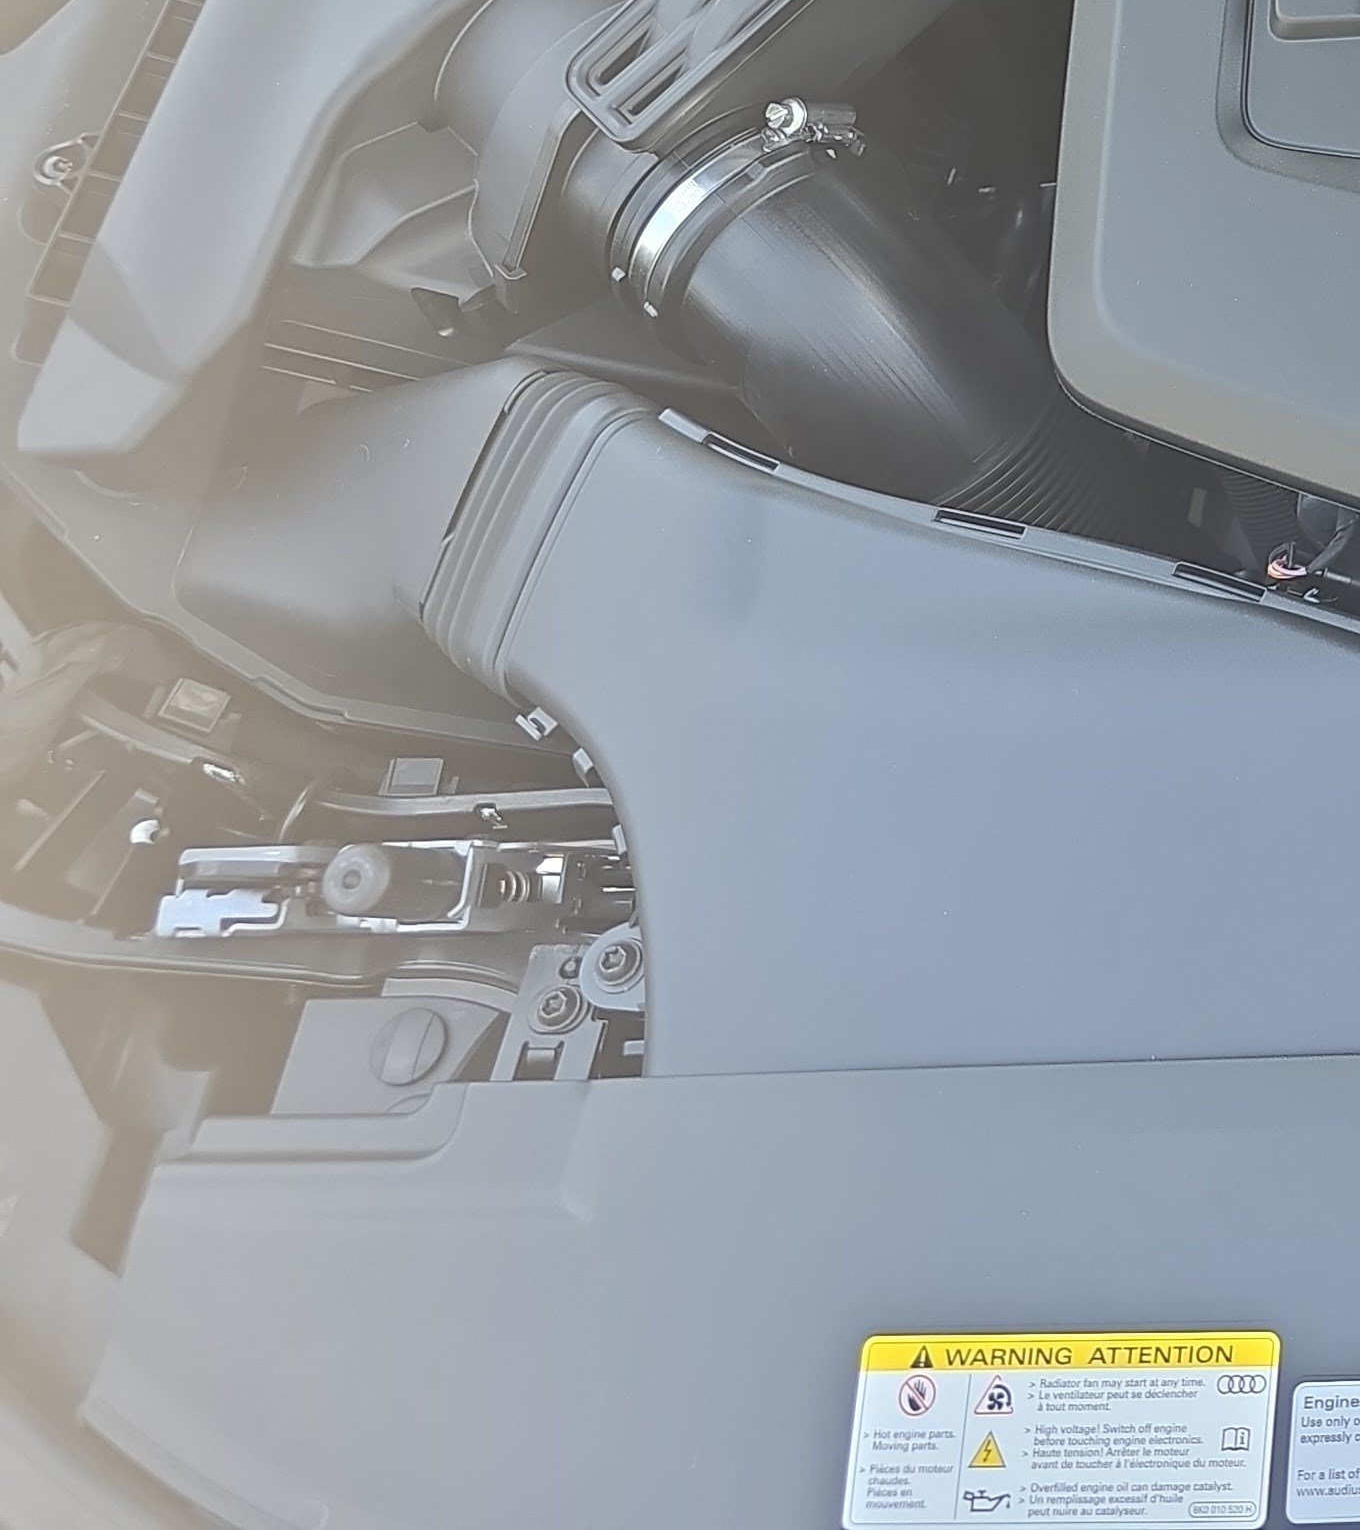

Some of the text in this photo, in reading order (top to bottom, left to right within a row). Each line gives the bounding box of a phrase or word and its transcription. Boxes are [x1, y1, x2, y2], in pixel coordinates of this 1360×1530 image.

[945, 1345, 1233, 1366] WARNING ATTENTION
[1039, 1378, 1080, 1388] Radiator
[1083, 1378, 1099, 1388] fan
[1101, 1380, 1121, 1390] may
[1125, 1378, 1147, 1387] start
[1161, 1379, 1179, 1390] any
[1038, 1390, 1050, 1400] Le
[1053, 1389, 1104, 1400] ventilateur
[1106, 1390, 1129, 1401] peut
[1045, 1402, 1065, 1412] tout
[1303, 1395, 1360, 1412] Engine
[1301, 1416, 1323, 1428] Use
[1326, 1415, 1351, 1429] only
[873, 1429, 891, 1439] Hot
[893, 1429, 926, 1441] engine
[1035, 1424, 1058, 1436] High
[1103, 1423, 1136, 1434] Switch
[1153, 1424, 1188, 1436] engine
[1033, 1436, 1065, 1447] before
[1068, 1436, 1111, 1448] touching
[1113, 1437, 1146, 1448] engine
[1300, 1430, 1352, 1446] expressly
[872, 1440, 909, 1452] Moving
[1032, 1447, 1062, 1458] Haute
[1154, 1447, 1190, 1457] moteur
[903, 1463, 915, 1474] du
[918, 1464, 954, 1474] moteur
[1030, 1460, 1058, 1470] avant
[1061, 1459, 1073, 1470] de
[1075, 1458, 1113, 1469] toucher
[1193, 1457, 1206, 1468] du
[1297, 1470, 1317, 1481] For
[1328, 1468, 1345, 1480] list
[1347, 1468, 1360, 1479] of
[1030, 1482, 1078, 1494] Overfilled
[1080, 1483, 1114, 1495] engine
[1116, 1481, 1129, 1493] oil
[1131, 1483, 1148, 1492] can
[1151, 1481, 1191, 1494] damage
[1029, 1494, 1044, 1504] Un
[1046, 1494, 1106, 1506] remplissage
[1108, 1493, 1148, 1504] excessif
[1027, 1507, 1051, 1518] peut
[1052, 1506, 1078, 1516] nuire
